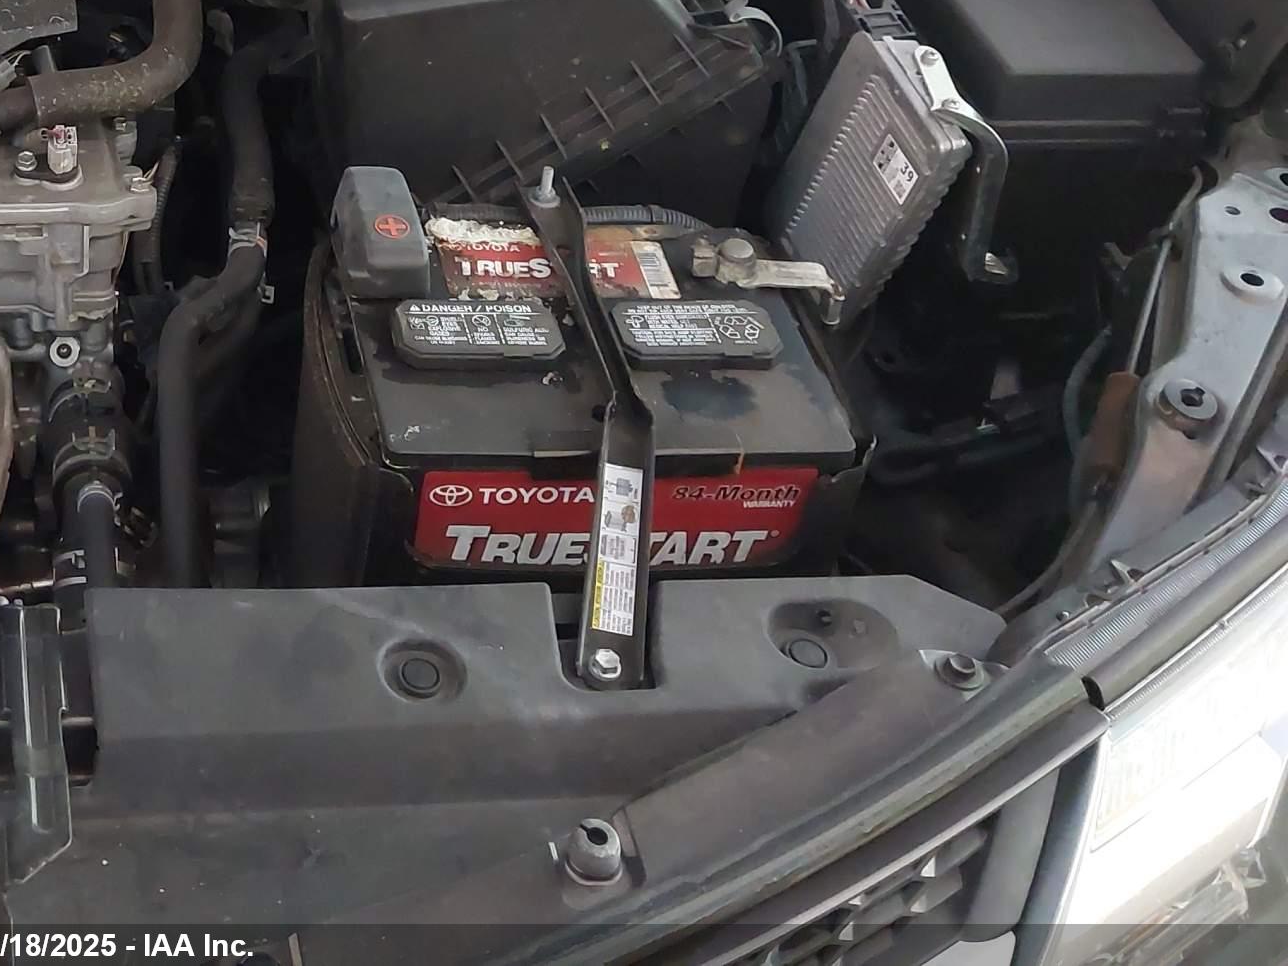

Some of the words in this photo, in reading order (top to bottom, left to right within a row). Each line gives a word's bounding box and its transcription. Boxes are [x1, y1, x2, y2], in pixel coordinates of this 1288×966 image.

[900, 161, 914, 182] 39
[422, 304, 473, 313] DANGER
[485, 304, 532, 313] POISON
[479, 487, 595, 504] TOYOTA
[673, 484, 800, 501] 84-Month
[446, 525, 769, 565] TRUEART
